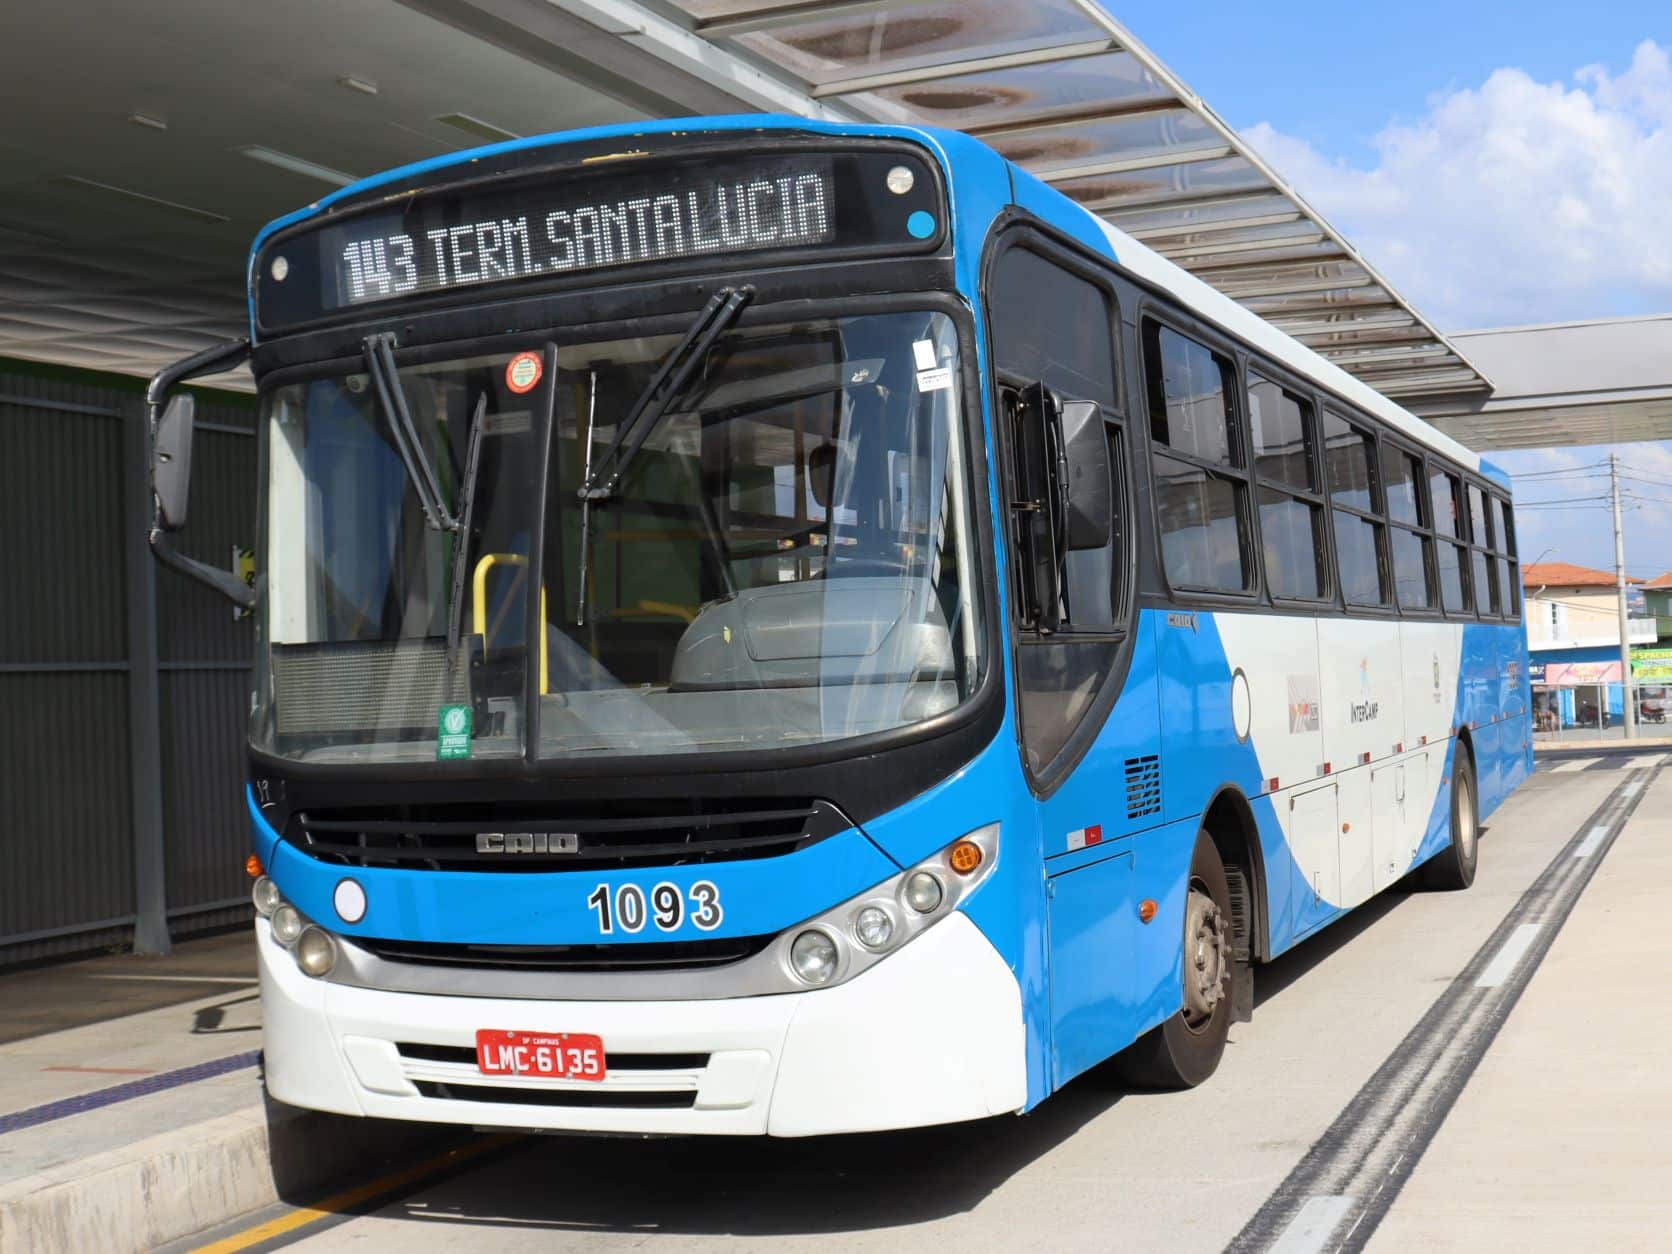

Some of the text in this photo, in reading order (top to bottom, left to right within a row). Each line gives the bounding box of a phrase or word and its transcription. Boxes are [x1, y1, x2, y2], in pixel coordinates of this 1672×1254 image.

[343, 174, 827, 297] 143 TERM. SANTA LUCIA
[476, 832, 579, 855] CAIO
[588, 880, 723, 933] 1093
